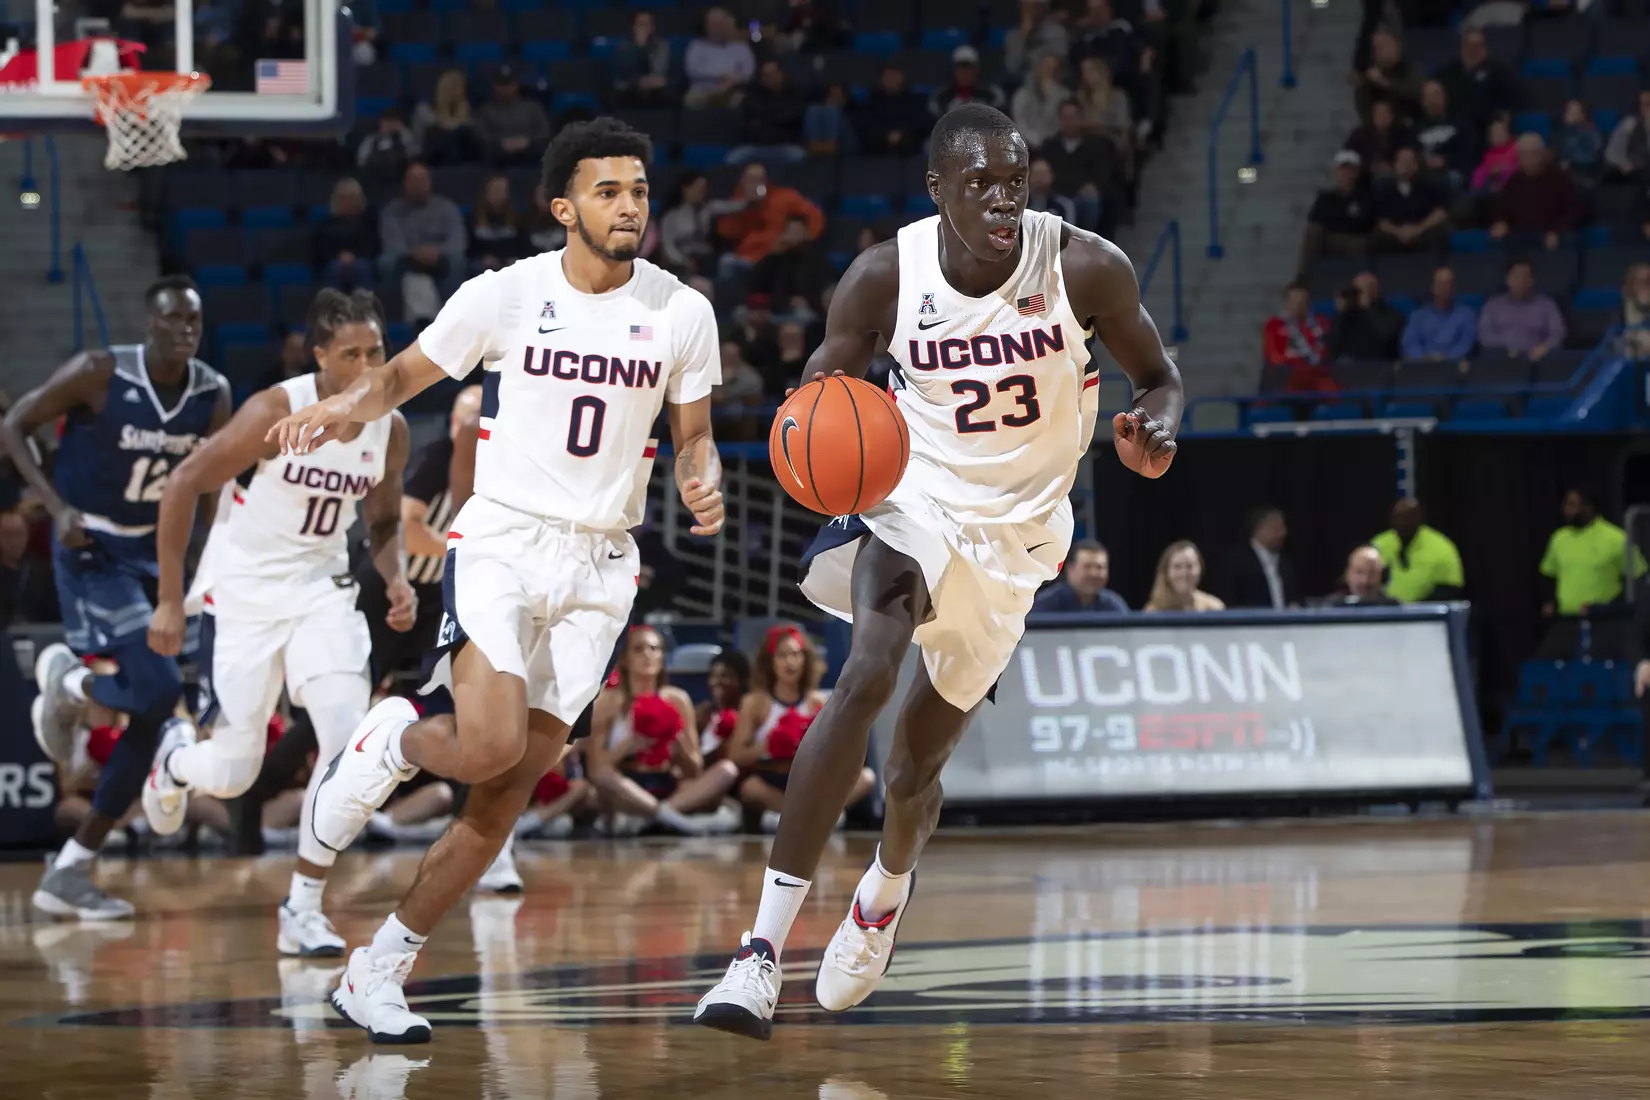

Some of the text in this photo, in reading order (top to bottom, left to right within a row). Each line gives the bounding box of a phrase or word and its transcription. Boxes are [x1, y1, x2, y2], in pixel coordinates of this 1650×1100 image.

[523, 345, 662, 389] UCONN
[909, 323, 1065, 371] UCONN
[566, 395, 607, 459] 0
[951, 374, 1041, 433] 23
[124, 456, 170, 502] 12
[299, 496, 342, 536] 10
[1020, 641, 1303, 707] UCONN
